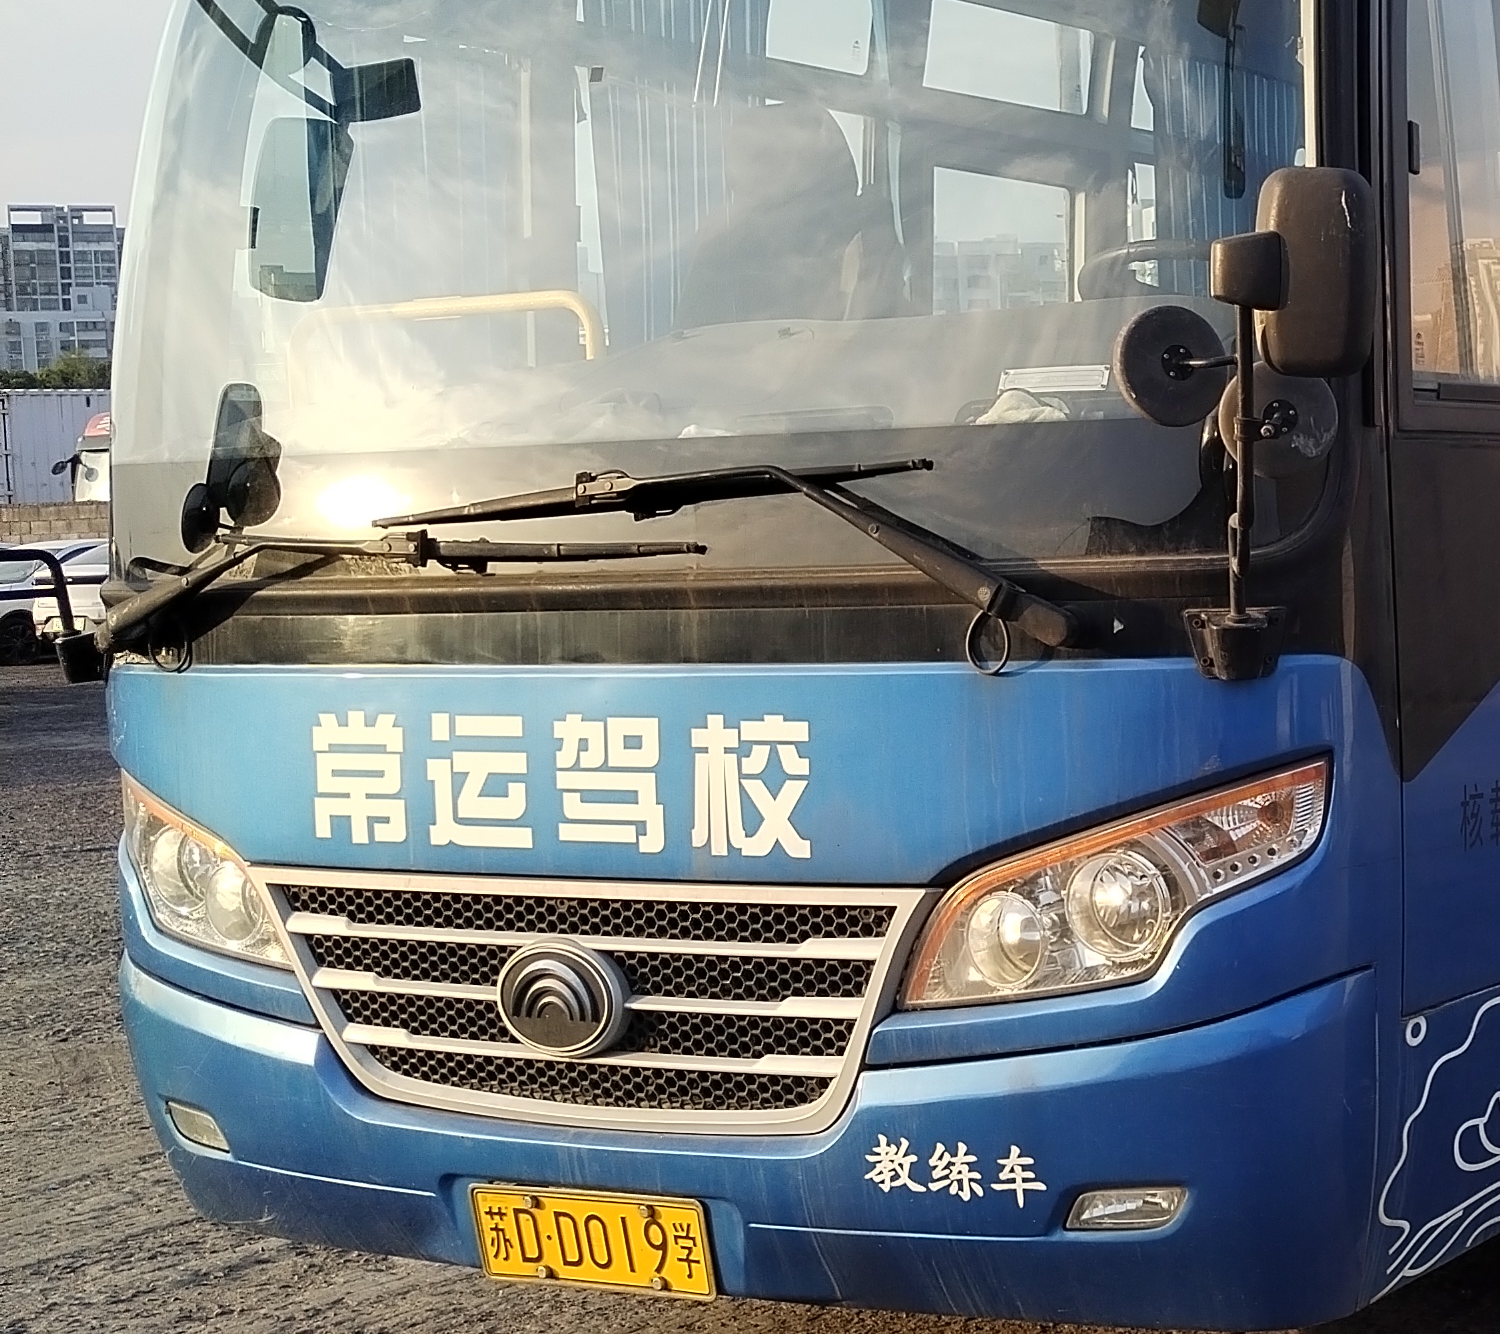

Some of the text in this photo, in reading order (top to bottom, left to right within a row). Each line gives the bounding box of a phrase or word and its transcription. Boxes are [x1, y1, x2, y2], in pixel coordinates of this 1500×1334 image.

[311, 710, 812, 859] 常运驾校
[864, 1133, 1048, 1209] 教练车
